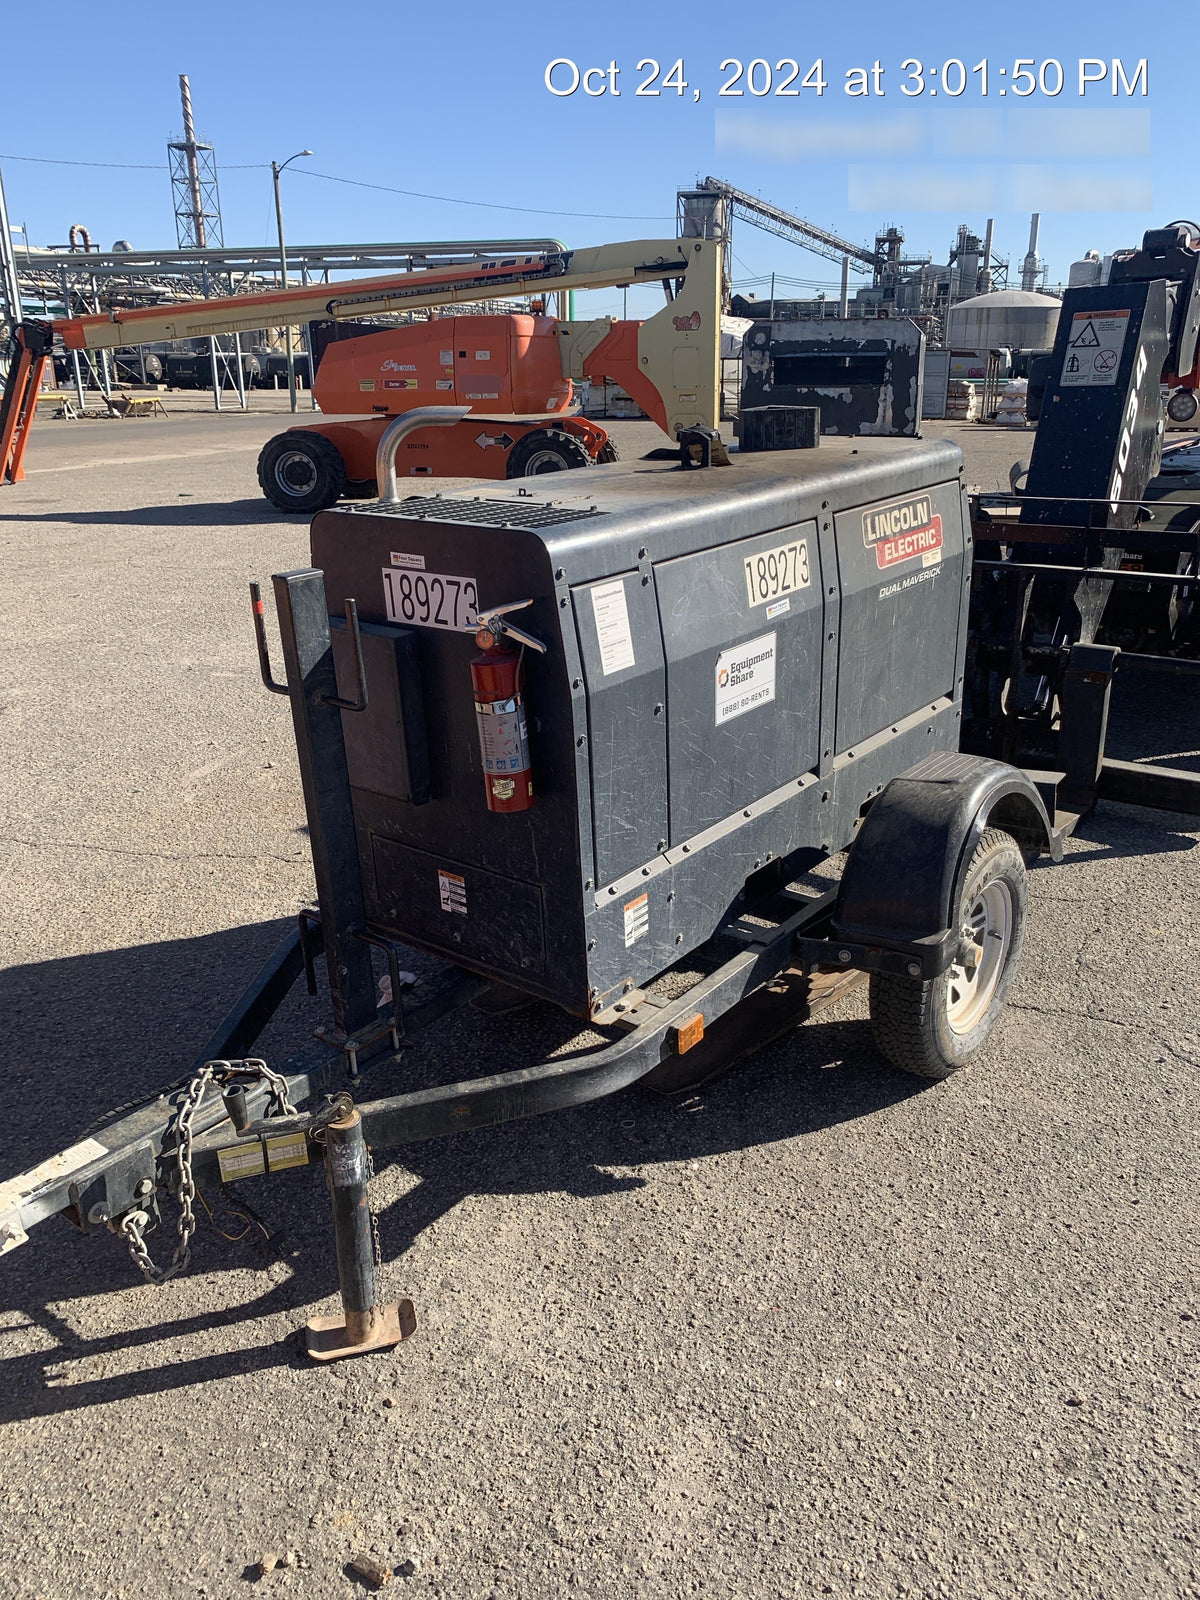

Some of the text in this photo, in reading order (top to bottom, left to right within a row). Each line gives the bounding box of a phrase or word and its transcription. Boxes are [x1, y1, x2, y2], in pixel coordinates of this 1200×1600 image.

[866, 501, 929, 541] LINCOLN
[884, 528, 937, 561] ELECTRIC
[746, 543, 809, 603] 189273
[879, 566, 941, 599] DUAL MAVERICK
[384, 573, 478, 627] 189273
[730, 647, 774, 674] Equipment
[730, 669, 754, 687] Share
[722, 687, 770, 716] (888) 80-RENTS
